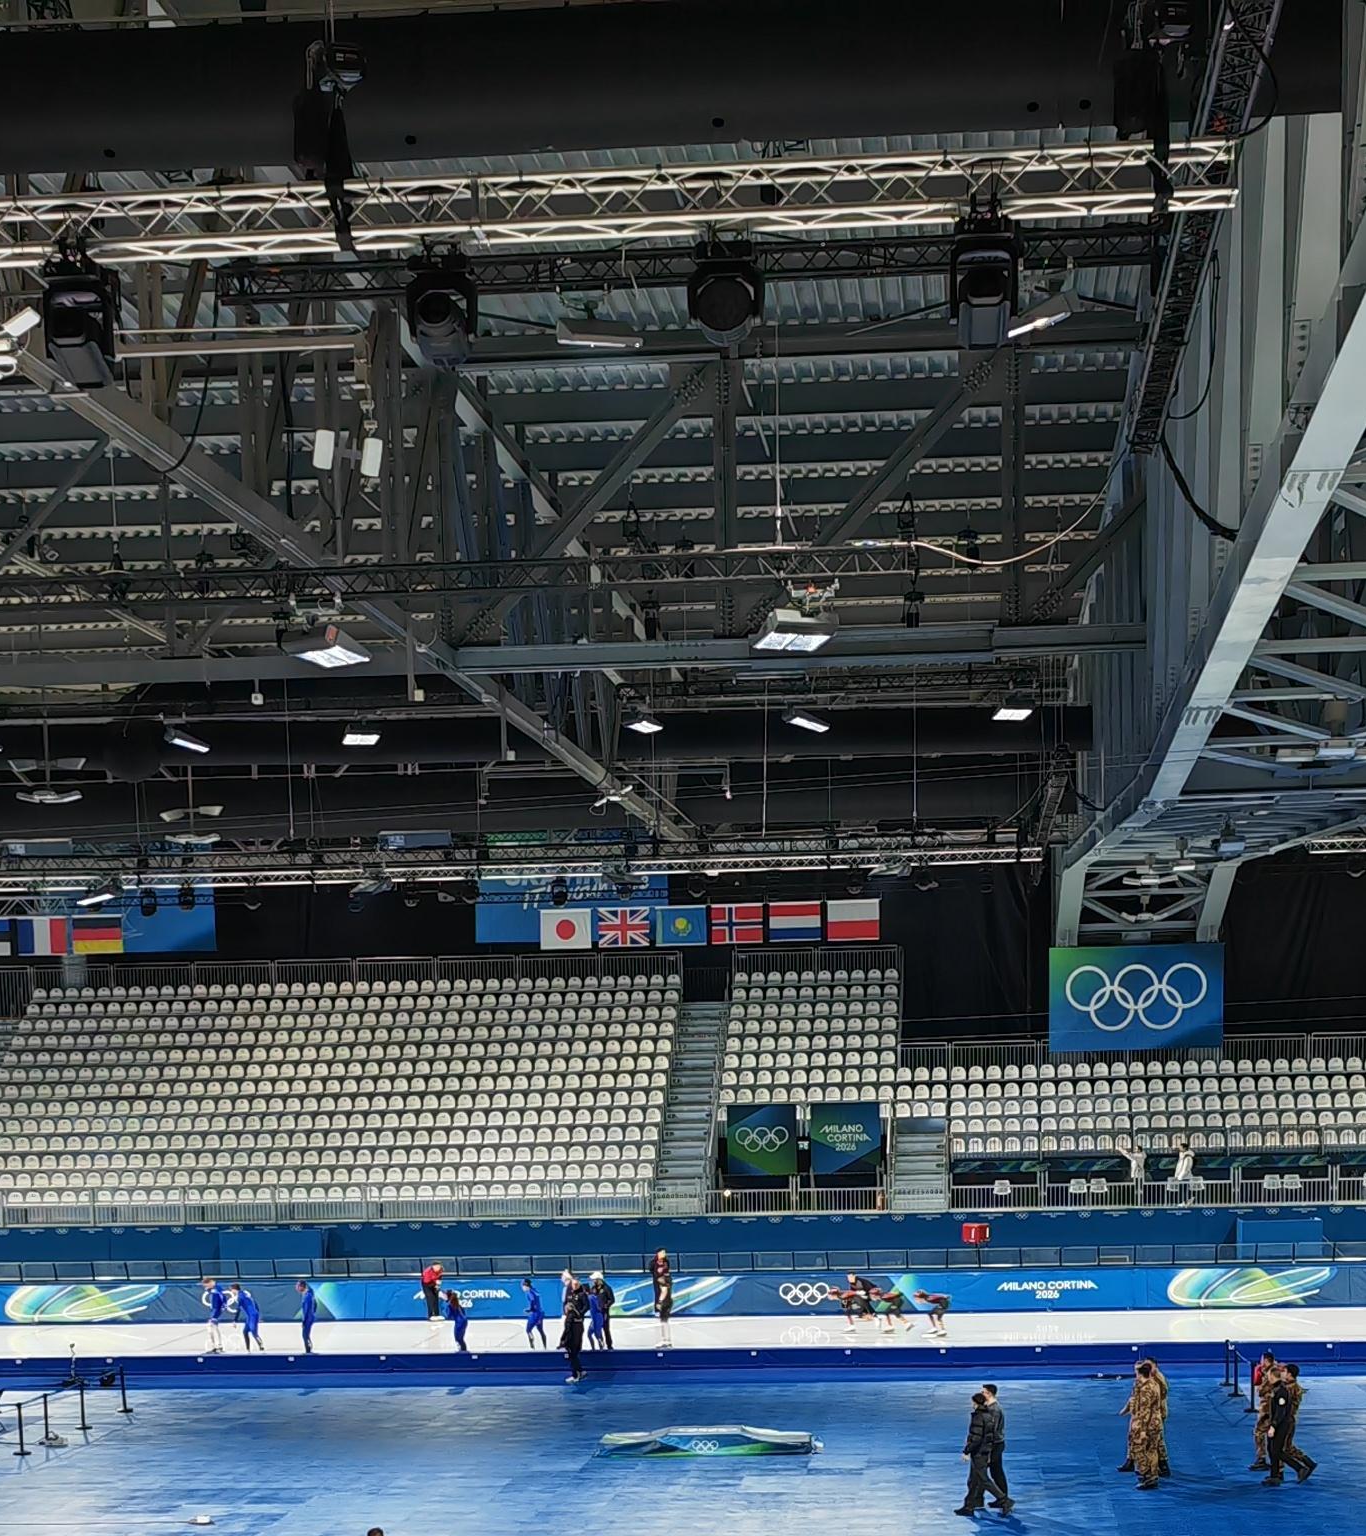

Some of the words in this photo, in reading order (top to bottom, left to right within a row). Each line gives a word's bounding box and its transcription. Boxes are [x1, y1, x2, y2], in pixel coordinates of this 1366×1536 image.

[819, 1123, 863, 1133] MILANO
[827, 1133, 872, 1142] CORTINA
[997, 1279, 1045, 1291] MILANO
[1047, 1279, 1097, 1291] CORTINA
[462, 1289, 511, 1299] CORTINA
[1035, 1289, 1060, 1299] 2026
